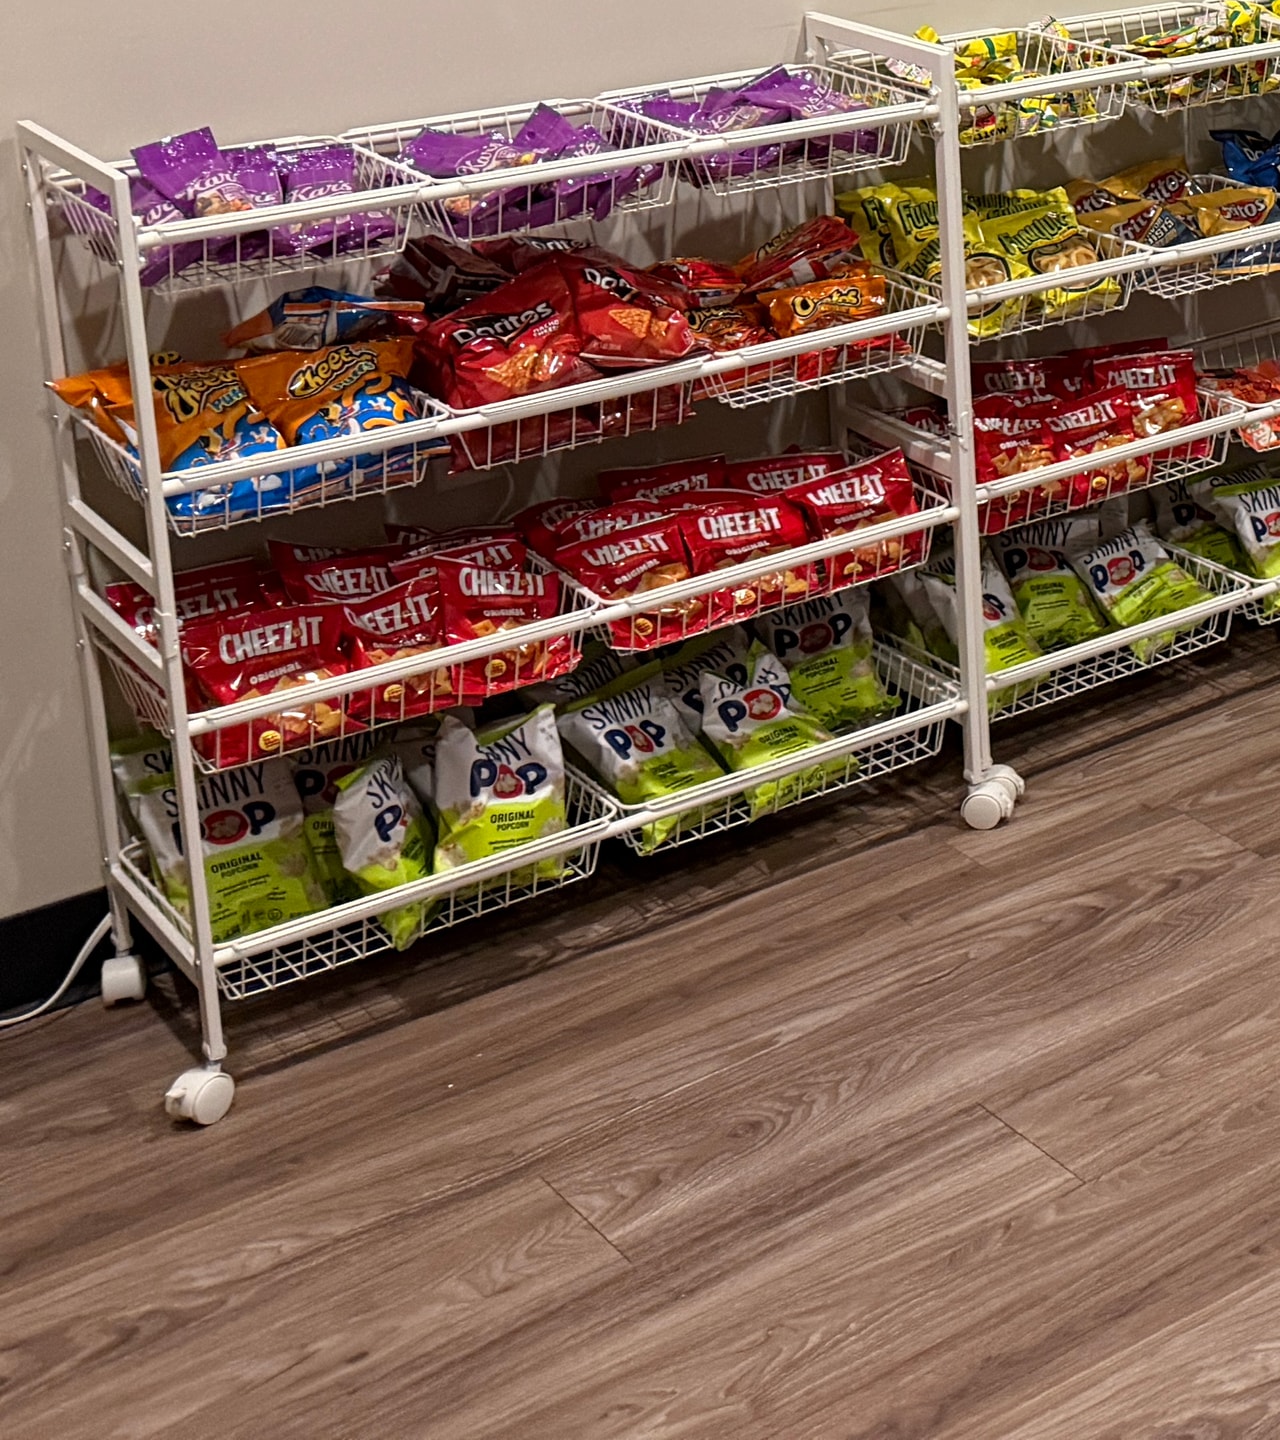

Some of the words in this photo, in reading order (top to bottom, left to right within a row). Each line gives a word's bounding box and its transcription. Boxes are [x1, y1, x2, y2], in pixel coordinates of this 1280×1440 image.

[289, 179, 353, 203] Kar's
[452, 302, 554, 344] Doritos
[773, 612, 853, 658] POP
[469, 758, 548, 799] POP
[489, 809, 536, 824] ORIGINAL
[496, 821, 530, 832] POPCORN
[210, 851, 264, 875] ORIGINAL
